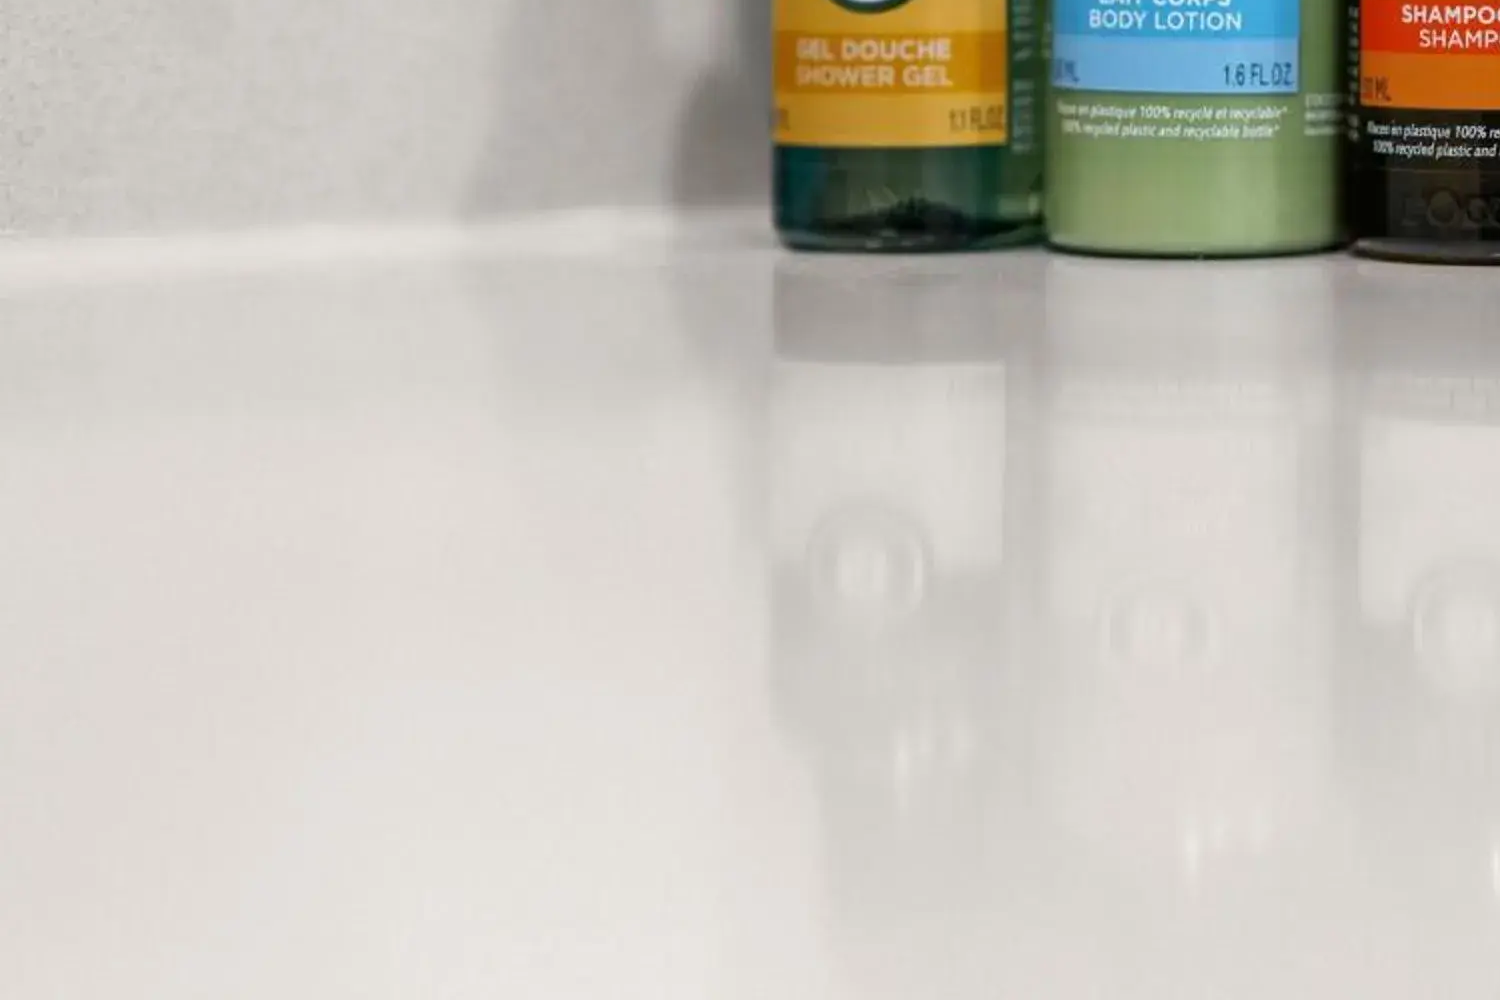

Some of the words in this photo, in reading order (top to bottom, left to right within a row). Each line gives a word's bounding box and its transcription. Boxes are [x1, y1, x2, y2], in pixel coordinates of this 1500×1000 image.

[1089, 9, 1147, 29] BODY
[1154, 12, 1242, 31] LOTION
[841, 38, 952, 60] DOUCHE
[902, 65, 953, 86] GEL
[1140, 105, 1170, 118] 100%
[1455, 125, 1487, 139] 100%
[1474, 143, 1497, 157] and
